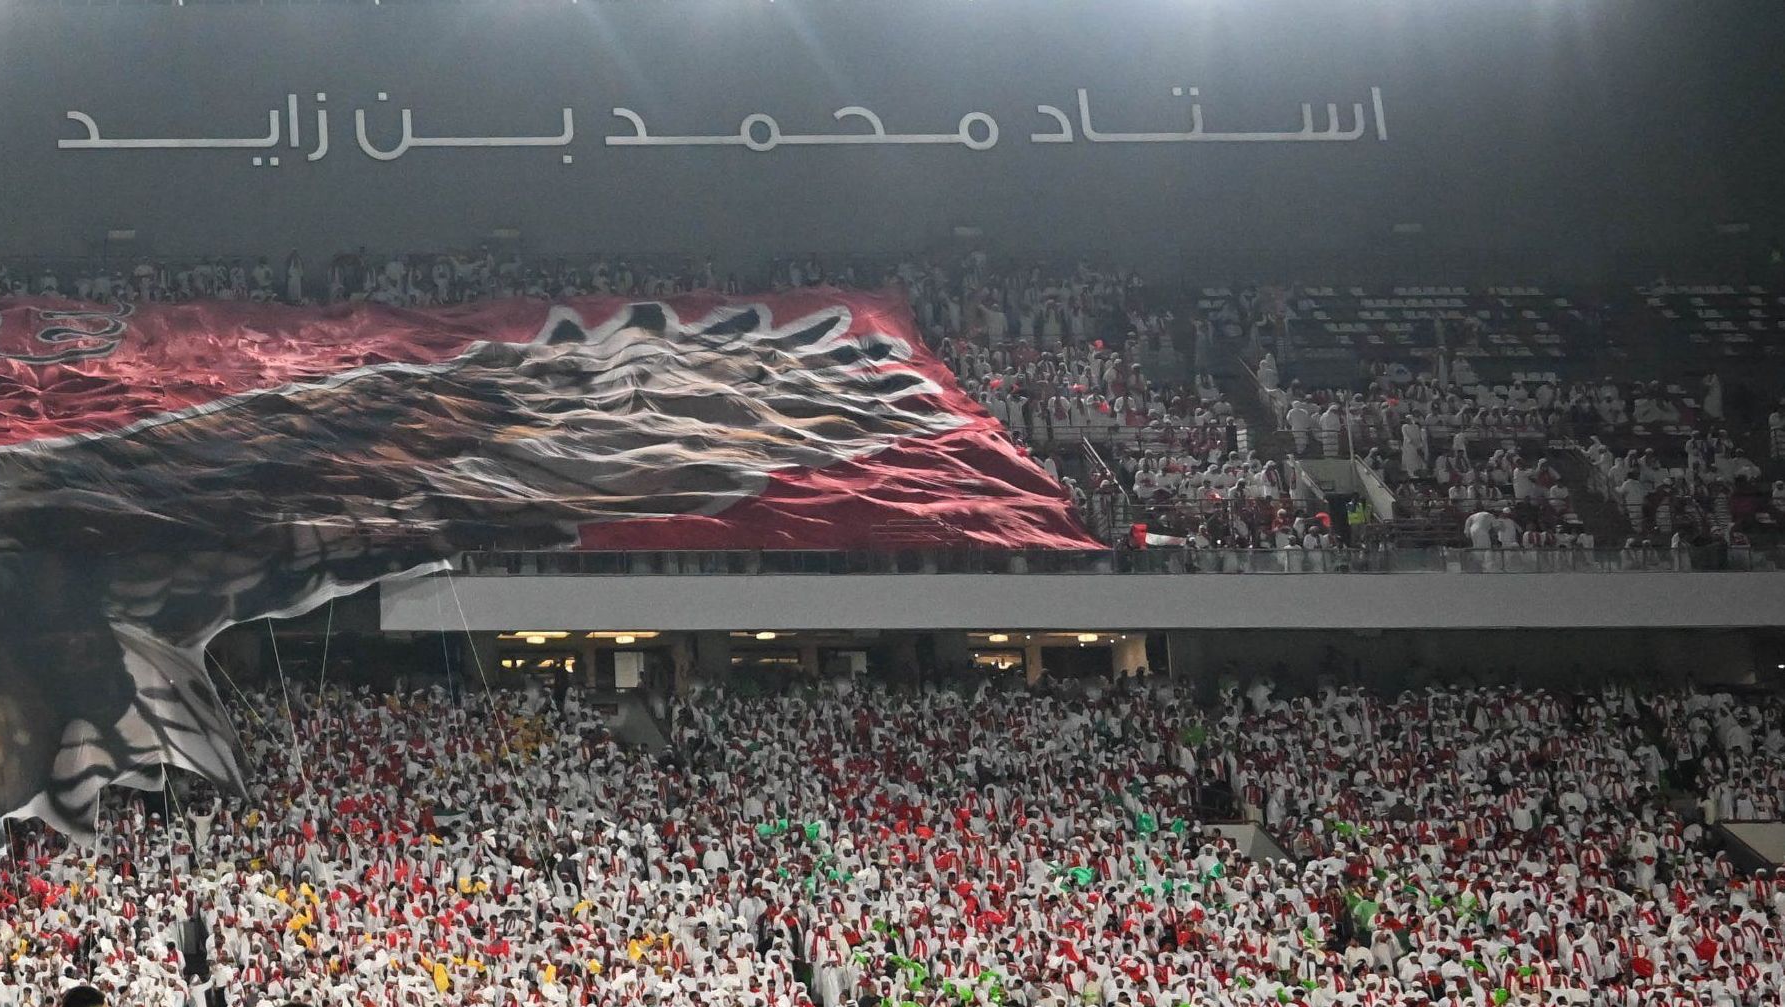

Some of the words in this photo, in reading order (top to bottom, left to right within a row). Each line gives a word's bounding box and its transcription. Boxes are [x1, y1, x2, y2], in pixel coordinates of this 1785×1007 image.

[57, 92, 329, 166] زايد
[355, 91, 574, 164] بن
[605, 105, 1000, 152] محمد
[1030, 86, 1388, 143] استاد
